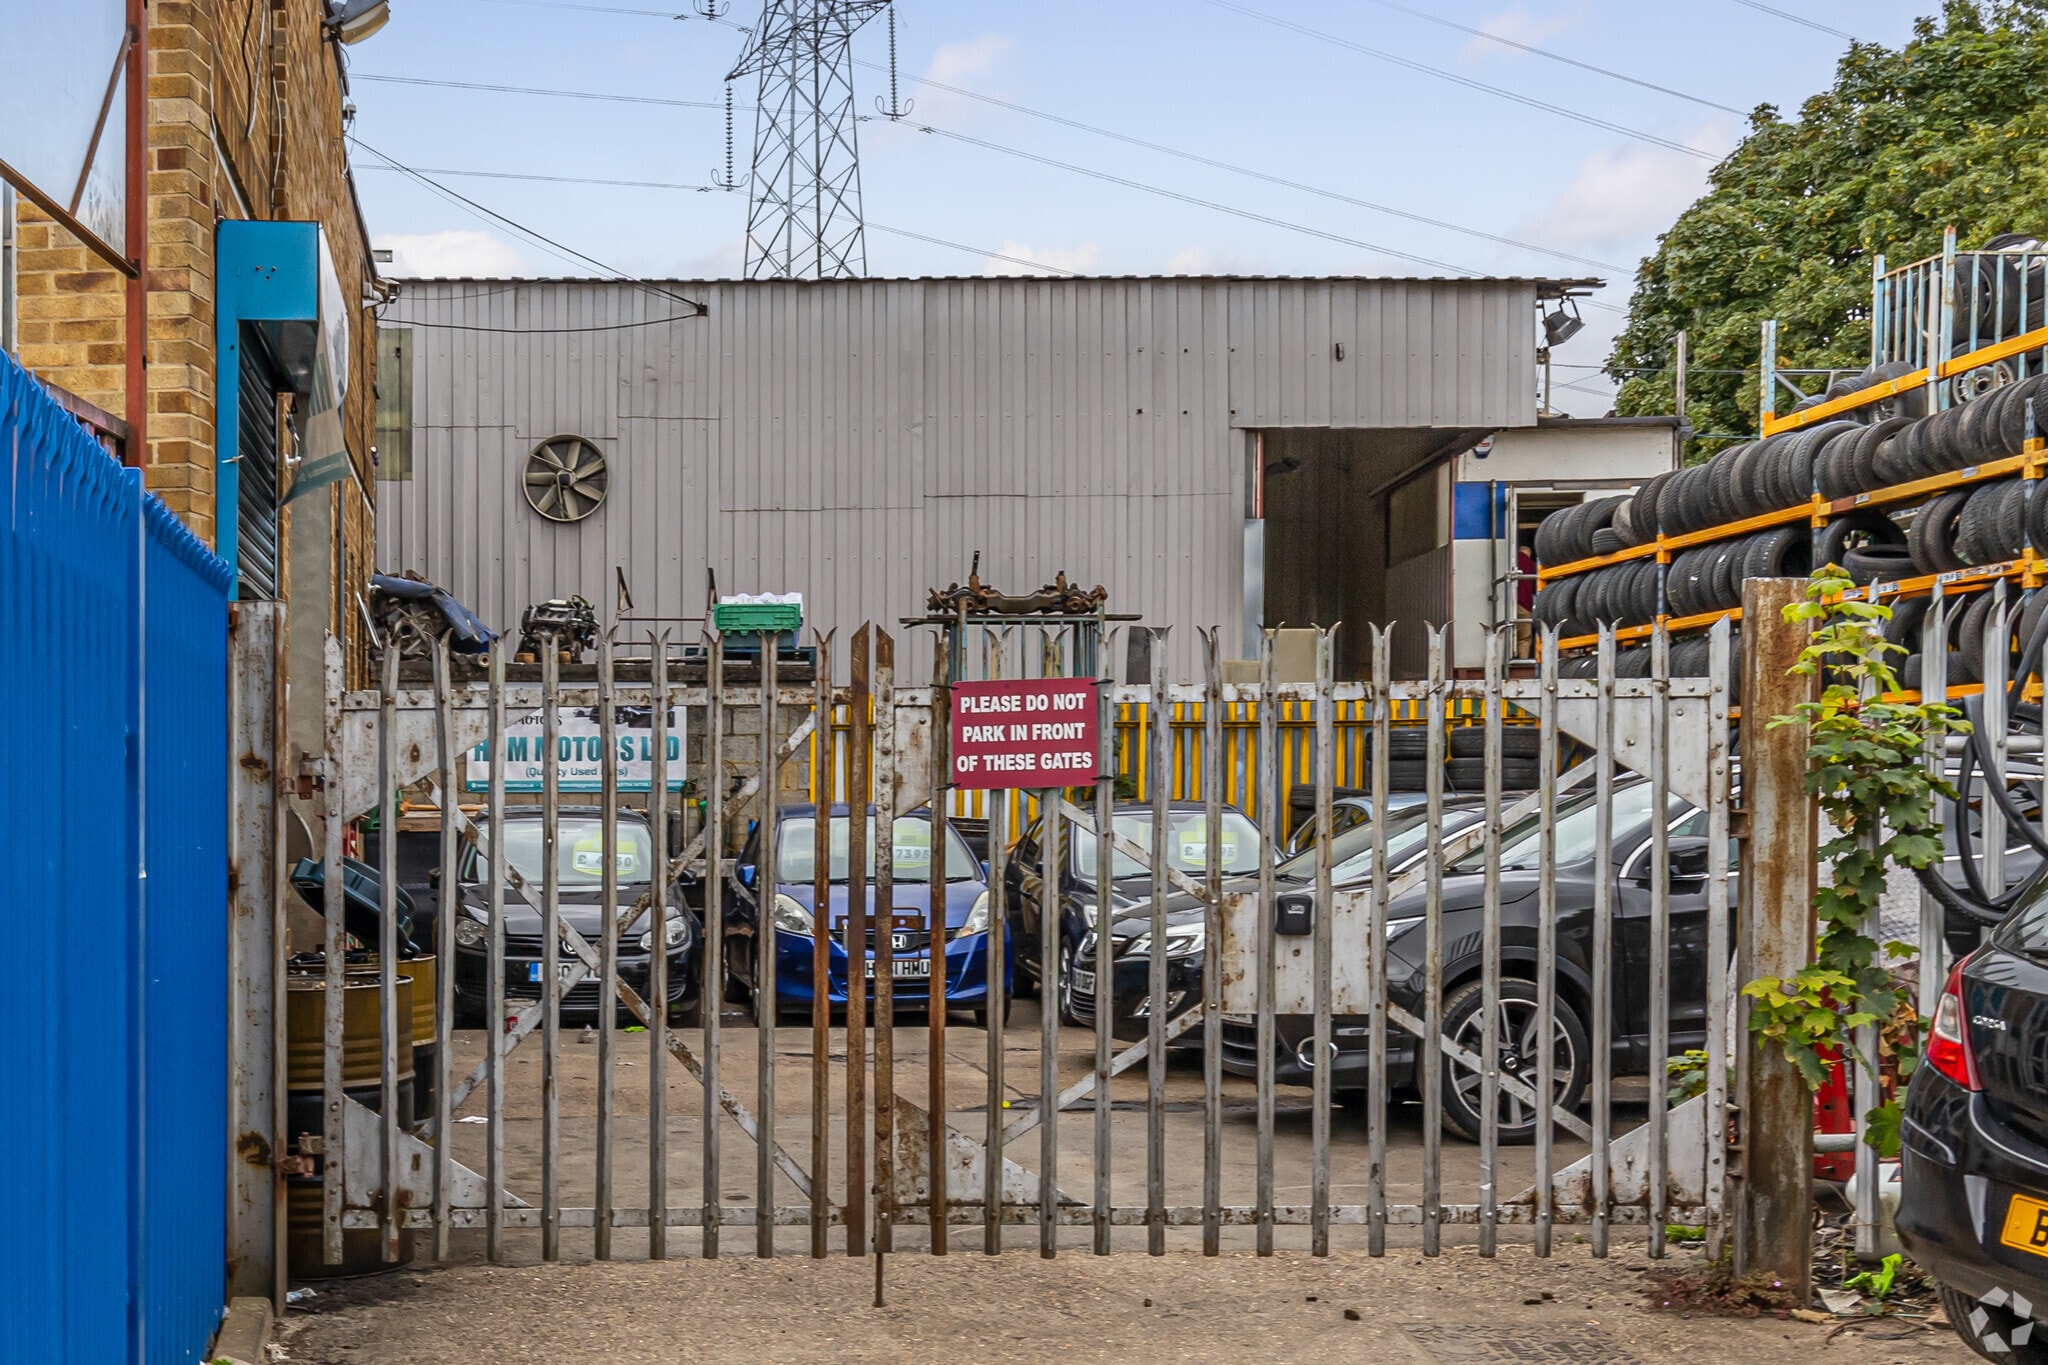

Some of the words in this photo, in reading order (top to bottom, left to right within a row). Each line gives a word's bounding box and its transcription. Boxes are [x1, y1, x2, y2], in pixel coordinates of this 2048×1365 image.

[960, 695, 1021, 713] PLEASE
[1025, 694, 1049, 711] DO
[1053, 693, 1087, 710] NOT
[962, 725, 1006, 742] PARK
[1010, 724, 1028, 741] IN
[1031, 722, 1086, 740] FRONT
[474, 737, 527, 761] HM
[641, 736, 679, 761] LD
[570, 767, 598, 775] Used
[957, 755, 979, 772] OF
[983, 753, 1036, 771] THESE
[1040, 751, 1093, 770] GATES
[896, 849, 930, 859] 7395
